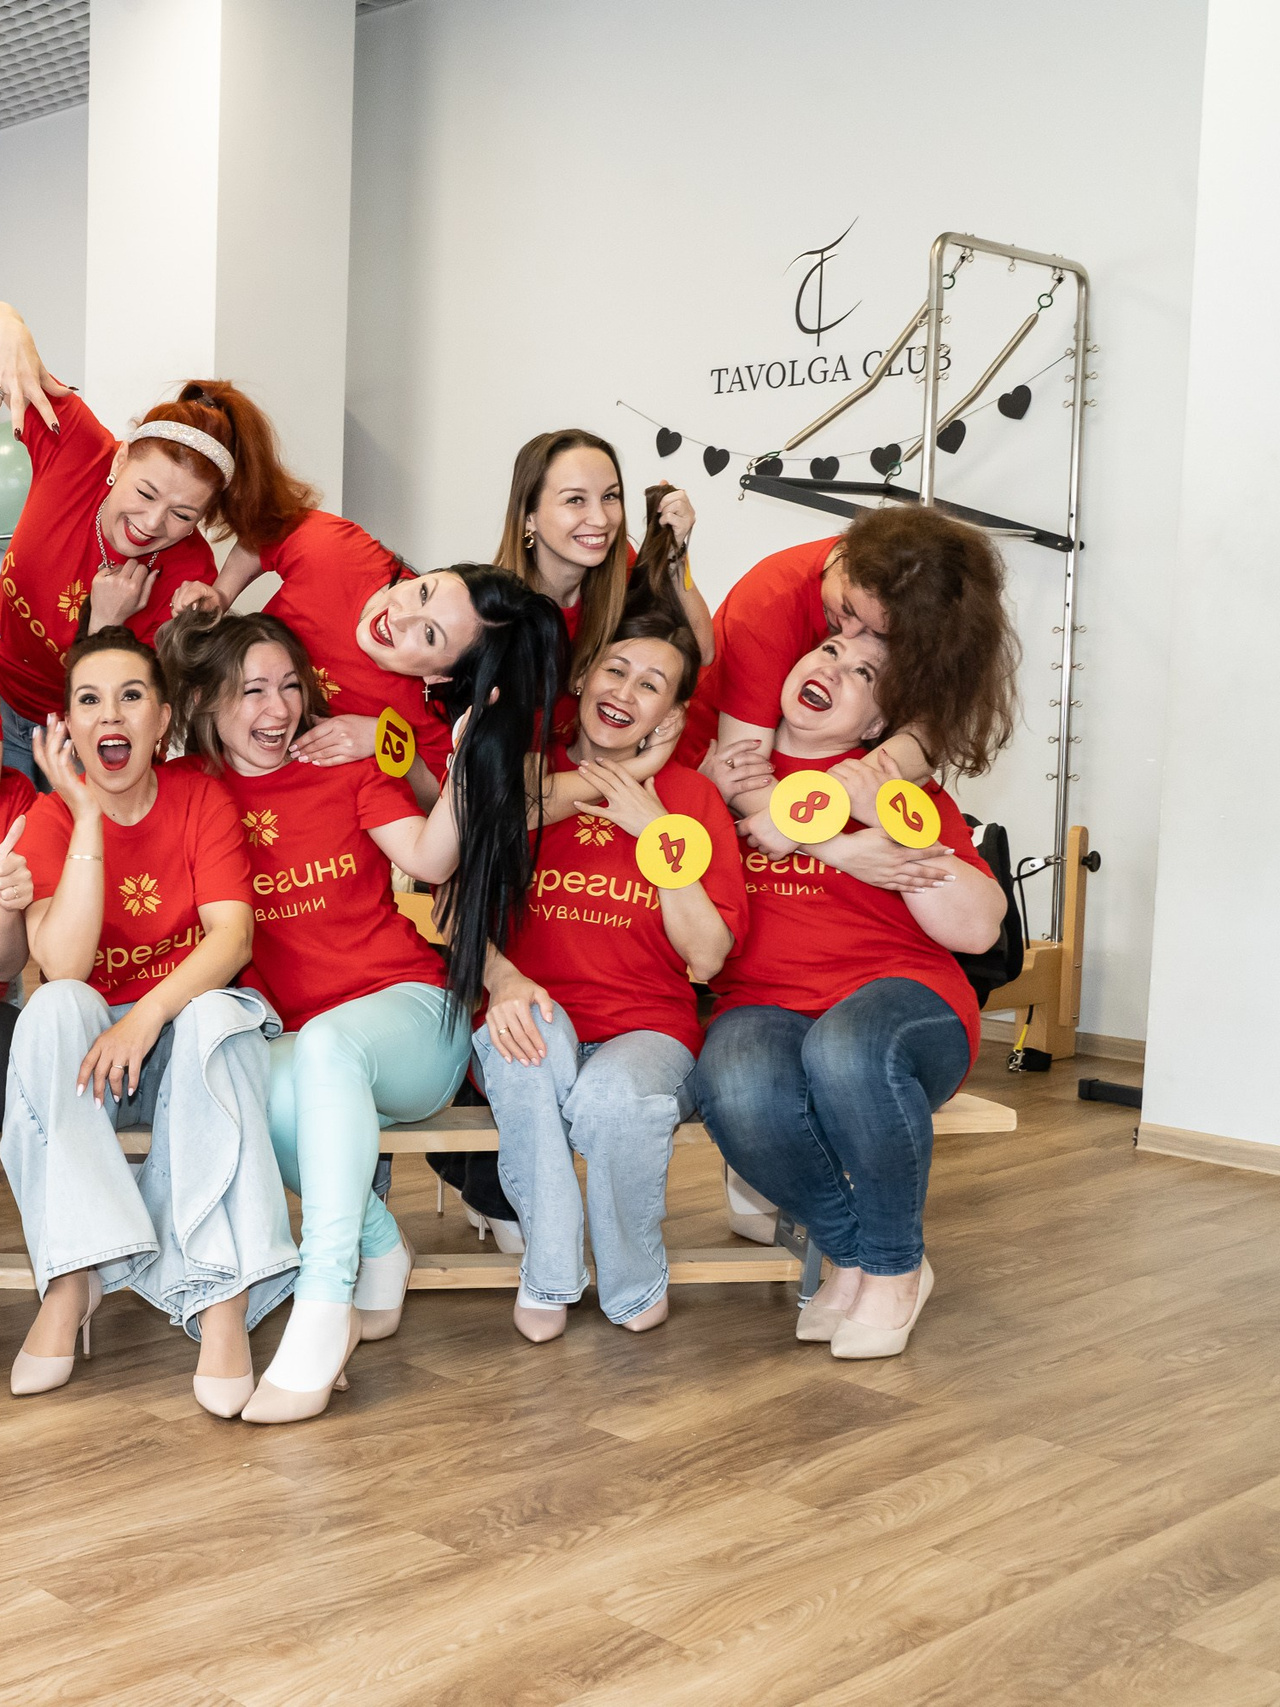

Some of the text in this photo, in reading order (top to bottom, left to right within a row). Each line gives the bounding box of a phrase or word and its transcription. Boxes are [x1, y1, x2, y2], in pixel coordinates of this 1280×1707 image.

[710, 355, 852, 394] TAVOLGA
[381, 720, 409, 763] 12
[789, 790, 830, 823] 8
[889, 791, 924, 832] 2
[658, 832, 686, 873] 4
[528, 904, 632, 929] чувашии
